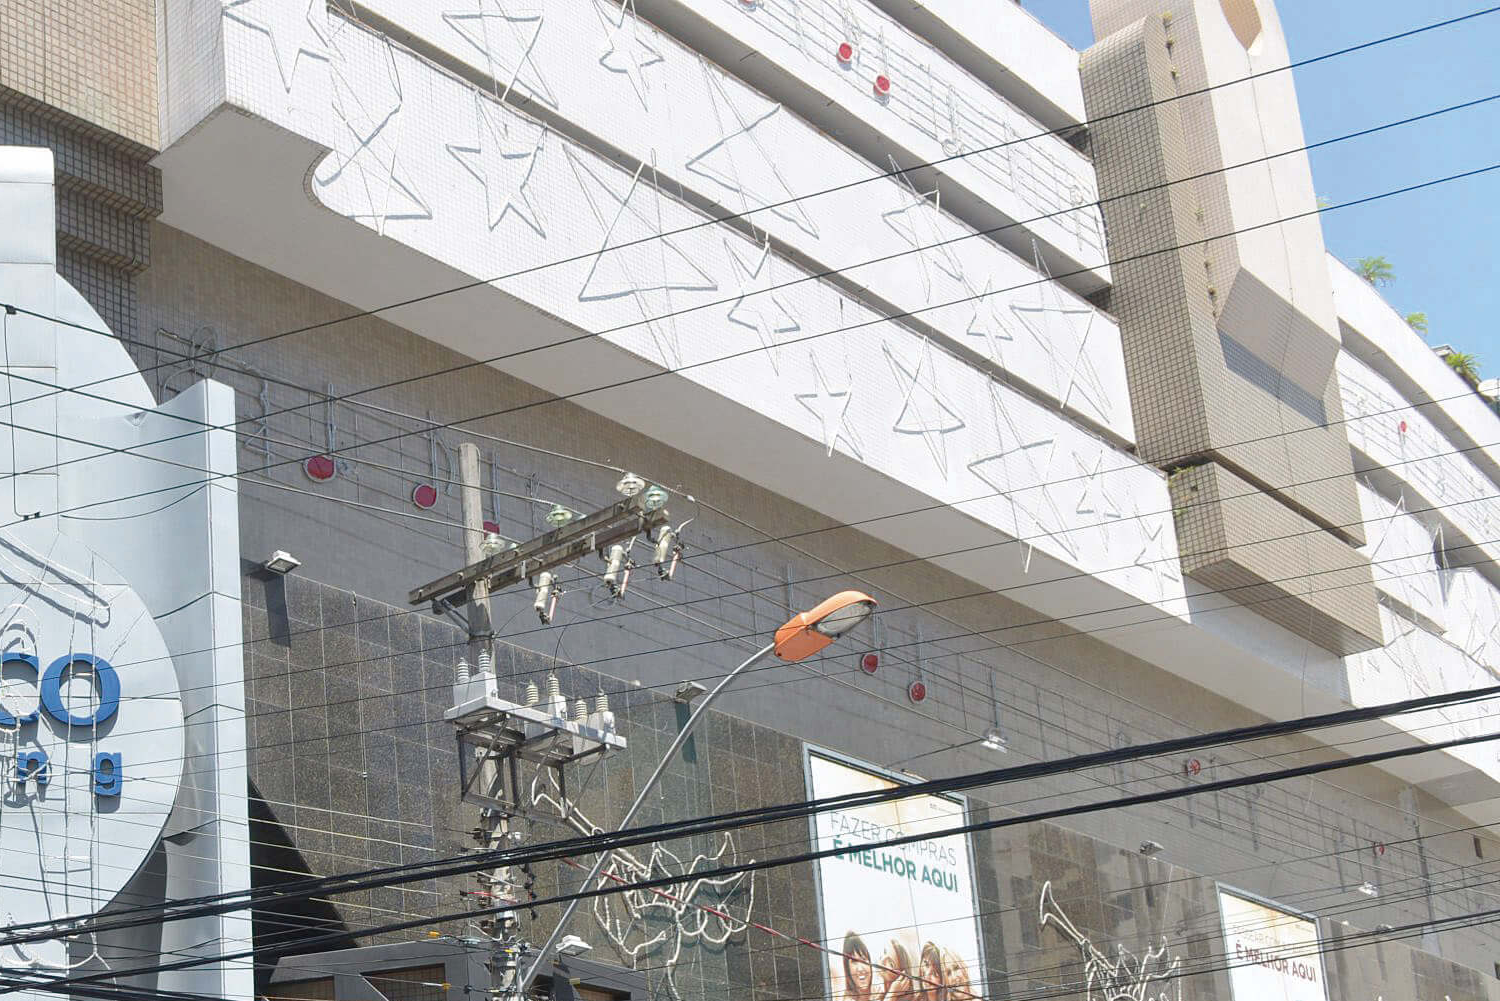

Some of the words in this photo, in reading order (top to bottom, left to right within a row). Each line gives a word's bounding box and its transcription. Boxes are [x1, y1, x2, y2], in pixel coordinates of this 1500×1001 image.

[830, 811, 882, 842] FAZER
[833, 835, 844, 860] É
[849, 842, 916, 880] MELHOR
[922, 864, 958, 893] AQUI
[1292, 961, 1317, 983] AQUI
